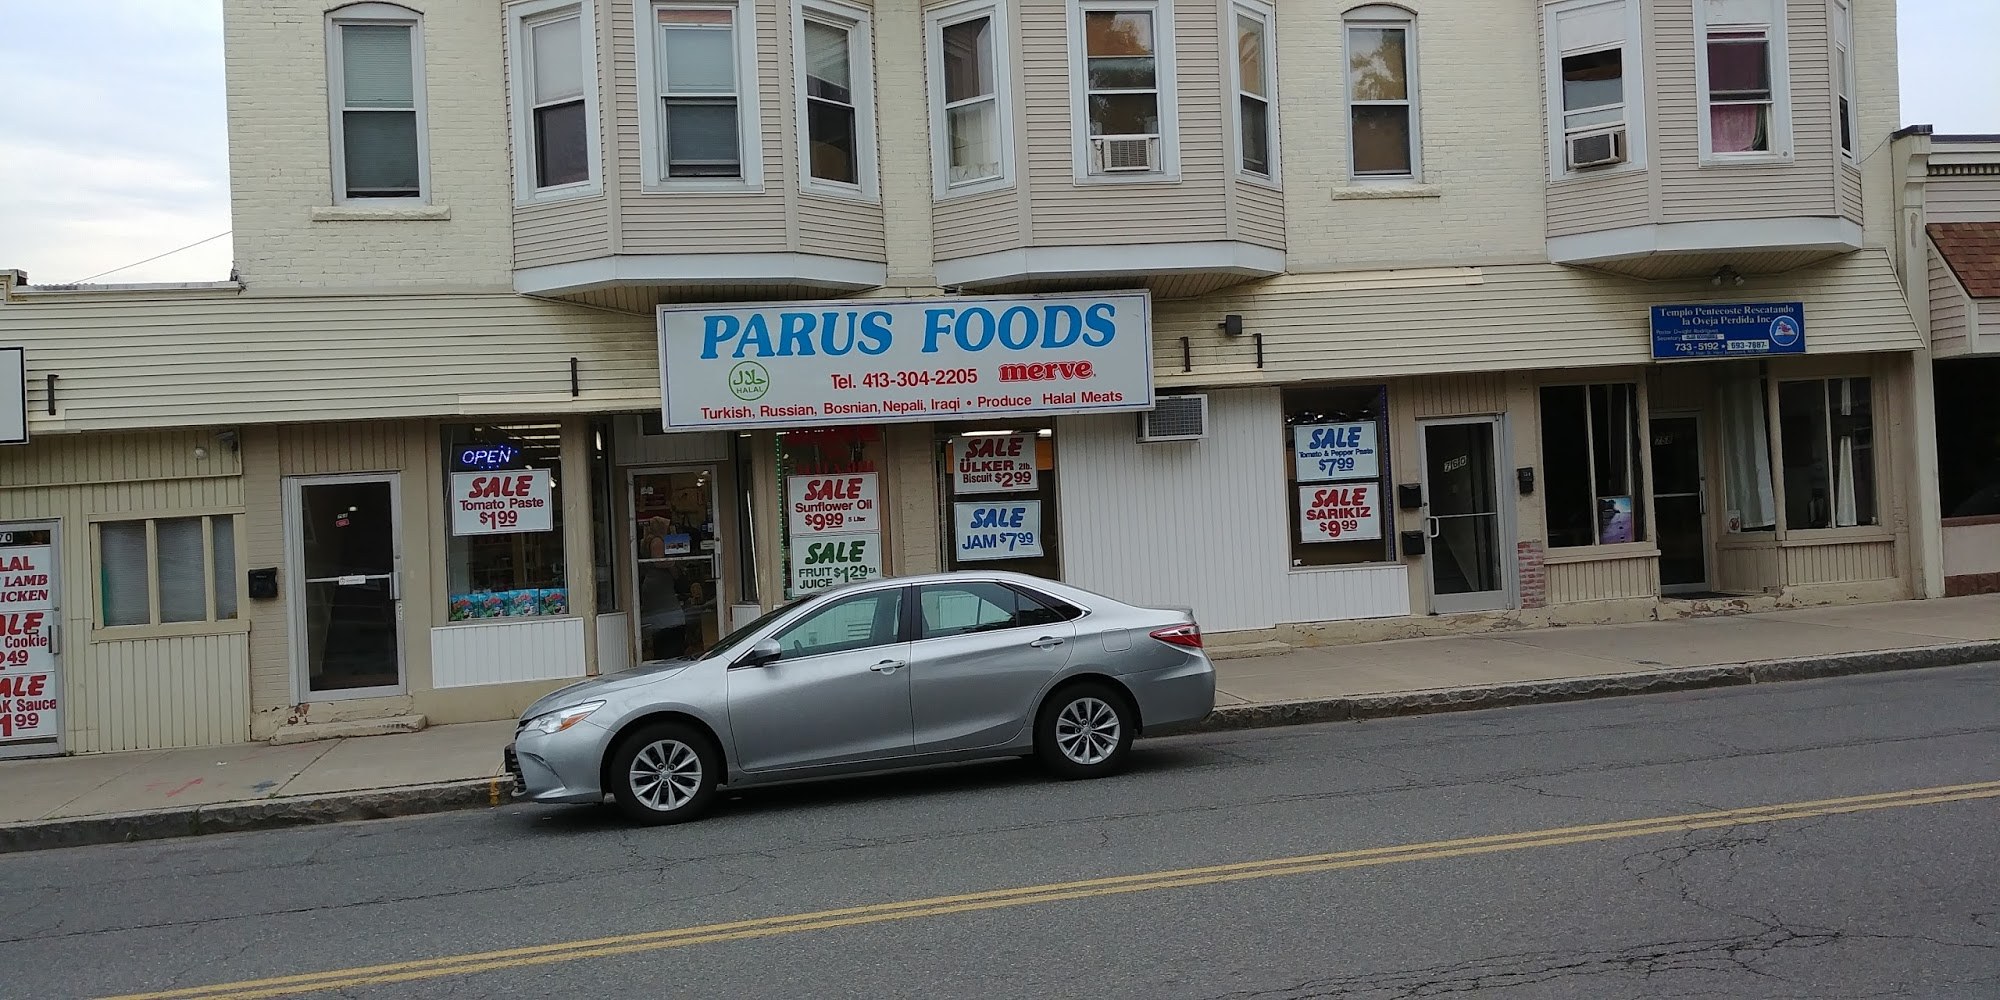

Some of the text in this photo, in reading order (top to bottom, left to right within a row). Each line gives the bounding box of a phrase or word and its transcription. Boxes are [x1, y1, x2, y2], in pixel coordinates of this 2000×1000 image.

[1660, 305, 1794, 318] Templo Pentecoste Rescatando
[1682, 315, 1773, 327] la Oveja Perdida Inc.
[700, 303, 1115, 359] PARUS FOODS
[831, 369, 978, 389] Tel. 413-304-2205
[998, 360, 1093, 382] merve
[736, 386, 763, 394] HALAL
[701, 390, 1123, 419] Turkish, Russian, Bosnian, Nepali, Iraqi Produce Halal Meats
[1309, 427, 1362, 449] SALE
[965, 437, 1024, 458] SALE
[1331, 449, 1354, 457] Pepper
[462, 449, 512, 465] OPEN
[960, 459, 1014, 473] ÜLKER
[963, 472, 992, 483] Biscuit
[468, 475, 533, 498] SALE
[804, 478, 863, 500] SALE
[459, 497, 544, 511] Tomato Paste
[1312, 487, 1367, 508] SALE
[795, 499, 872, 513] Sunflower Oil
[1306, 506, 1371, 520] SARIKIZ
[970, 507, 1026, 528] SALE
[962, 534, 997, 550] JAM
[804, 541, 866, 565] SALE
[798, 567, 833, 578] FRUIT
[4, 575, 48, 588] LAMB
[799, 578, 833, 589] JUICE
[5, 633, 48, 649] Cookie
[16, 698, 57, 712] Sauce
